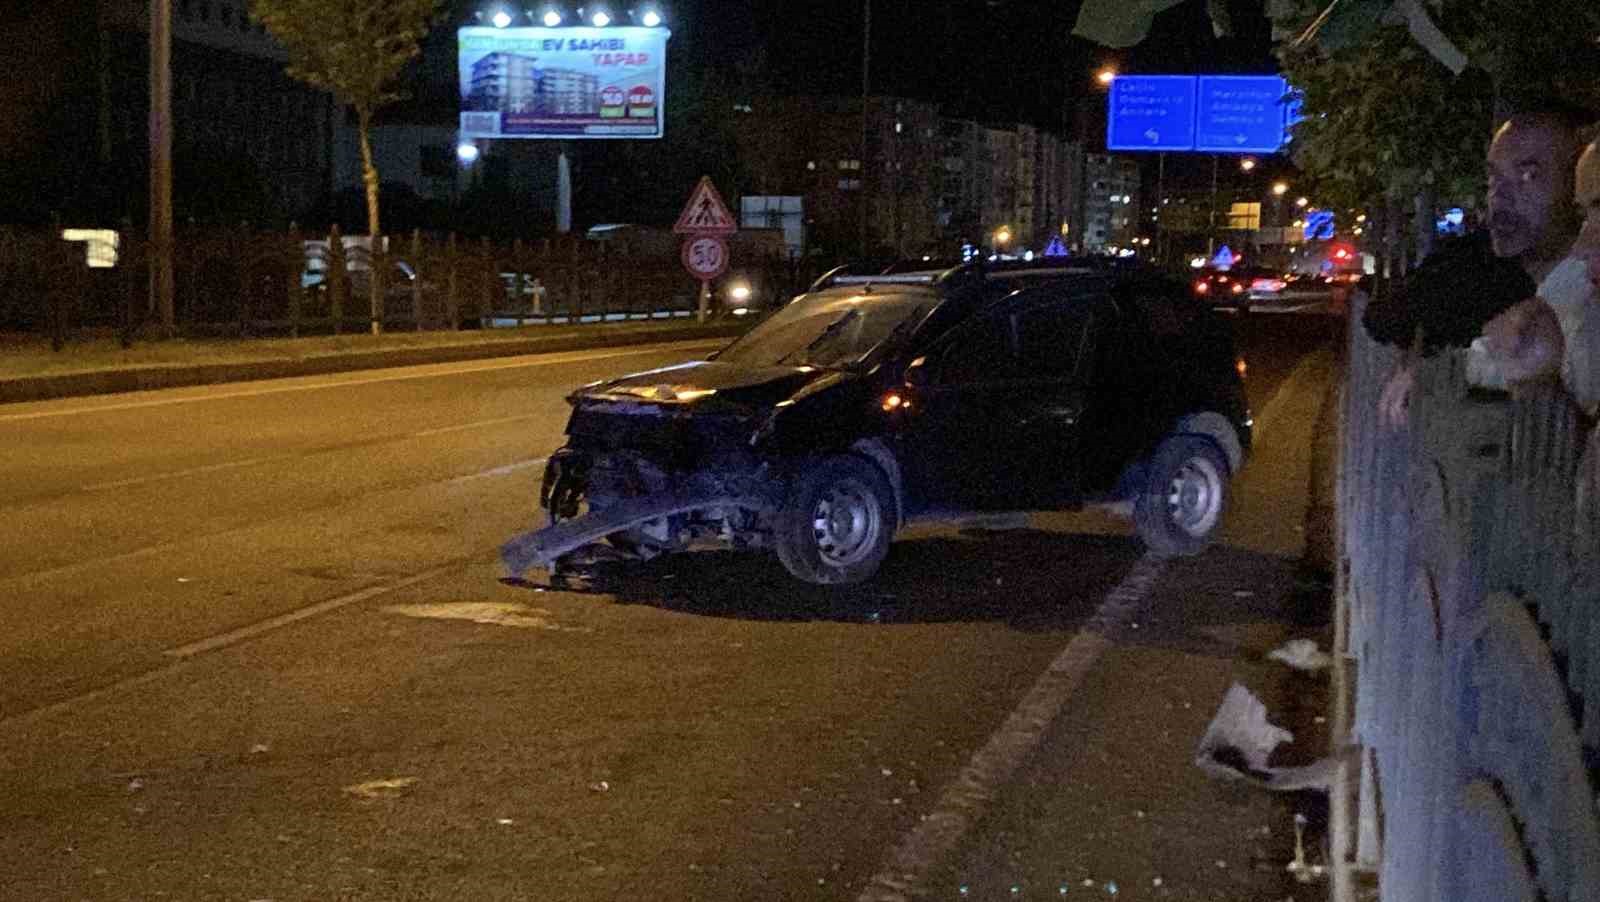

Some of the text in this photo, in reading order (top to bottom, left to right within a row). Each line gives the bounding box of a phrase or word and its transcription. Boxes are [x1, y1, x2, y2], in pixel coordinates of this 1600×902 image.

[542, 38, 565, 51] EV
[592, 53, 649, 66] YAPAR
[694, 245, 719, 266] 50
